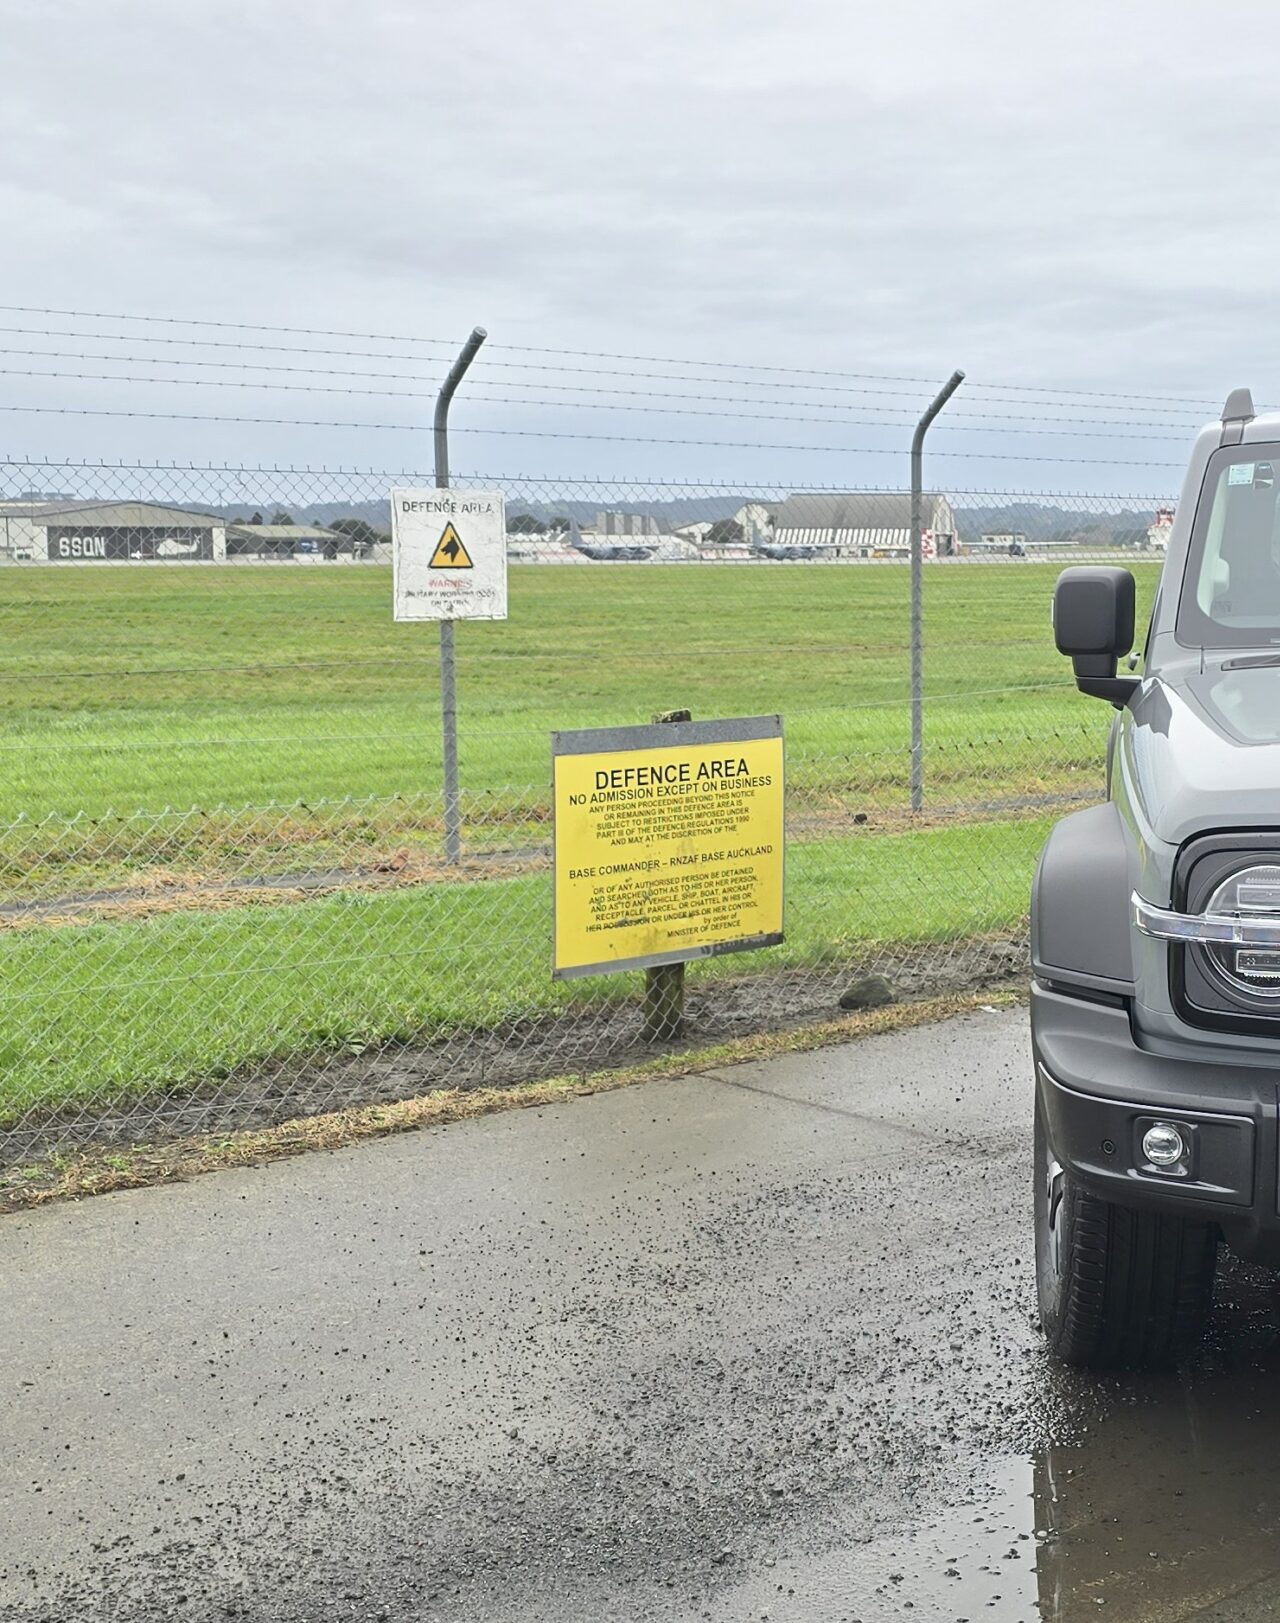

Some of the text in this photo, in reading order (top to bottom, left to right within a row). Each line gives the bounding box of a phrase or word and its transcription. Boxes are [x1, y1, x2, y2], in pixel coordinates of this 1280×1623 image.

[402, 501, 494, 513] DEFENCE AREA
[59, 536, 106, 557] 6SQN
[596, 758, 749, 790] DEFENCE AREA
[569, 776, 772, 806] NO ADMISSION EXCEPT ON BUSINESS
[589, 790, 755, 813] ANY PERSON PROCEEDING BEYOND THIS NOTICE
[596, 820, 630, 830] SUBJECT
[643, 813, 693, 824] RESTRICTIONS
[695, 810, 725, 819] IMPOSED
[726, 807, 749, 815] UNDER
[617, 809, 656, 818] REMAINING
[667, 805, 682, 813] THIS
[684, 802, 714, 811] DEFENCE
[717, 800, 735, 808] AREA
[596, 831, 615, 839] PART
[638, 826, 651, 834] THE
[653, 822, 685, 832] DEFENCE
[687, 817, 734, 828] REGULATIONS
[736, 815, 749, 823] 1990
[610, 838, 626, 846] AND
[628, 836, 643, 844] MAY
[657, 832, 670, 840] THE
[671, 828, 712, 839] DISCRETION
[714, 826, 722, 834] OF
[569, 868, 596, 879] BASE
[599, 860, 660, 876] COMMANDER
[670, 855, 699, 866] RNZAF
[702, 851, 725, 862] BASE
[727, 845, 773, 859] AUCKLAND
[589, 896, 605, 904] AND
[607, 891, 646, 902] SEARCHED
[716, 879, 729, 887] HER
[593, 887, 604, 895] OR
[618, 883, 633, 891] ANY
[635, 877, 680, 889] AUTHORISED
[681, 874, 709, 883] PERSON
[711, 872, 719, 880] BE
[721, 867, 754, 877] DETAINED
[591, 905, 607, 913] AND
[632, 899, 647, 907] ANY
[690, 897, 721, 907] CHATTEL
[586, 923, 602, 932] HER
[664, 911, 687, 921] UNDER
[713, 905, 727, 913] HER
[728, 901, 758, 911] CONTROL
[667, 919, 741, 937] MINISTER OF DEFENCE
[703, 917, 711, 925] by
[713, 914, 729, 922] order
